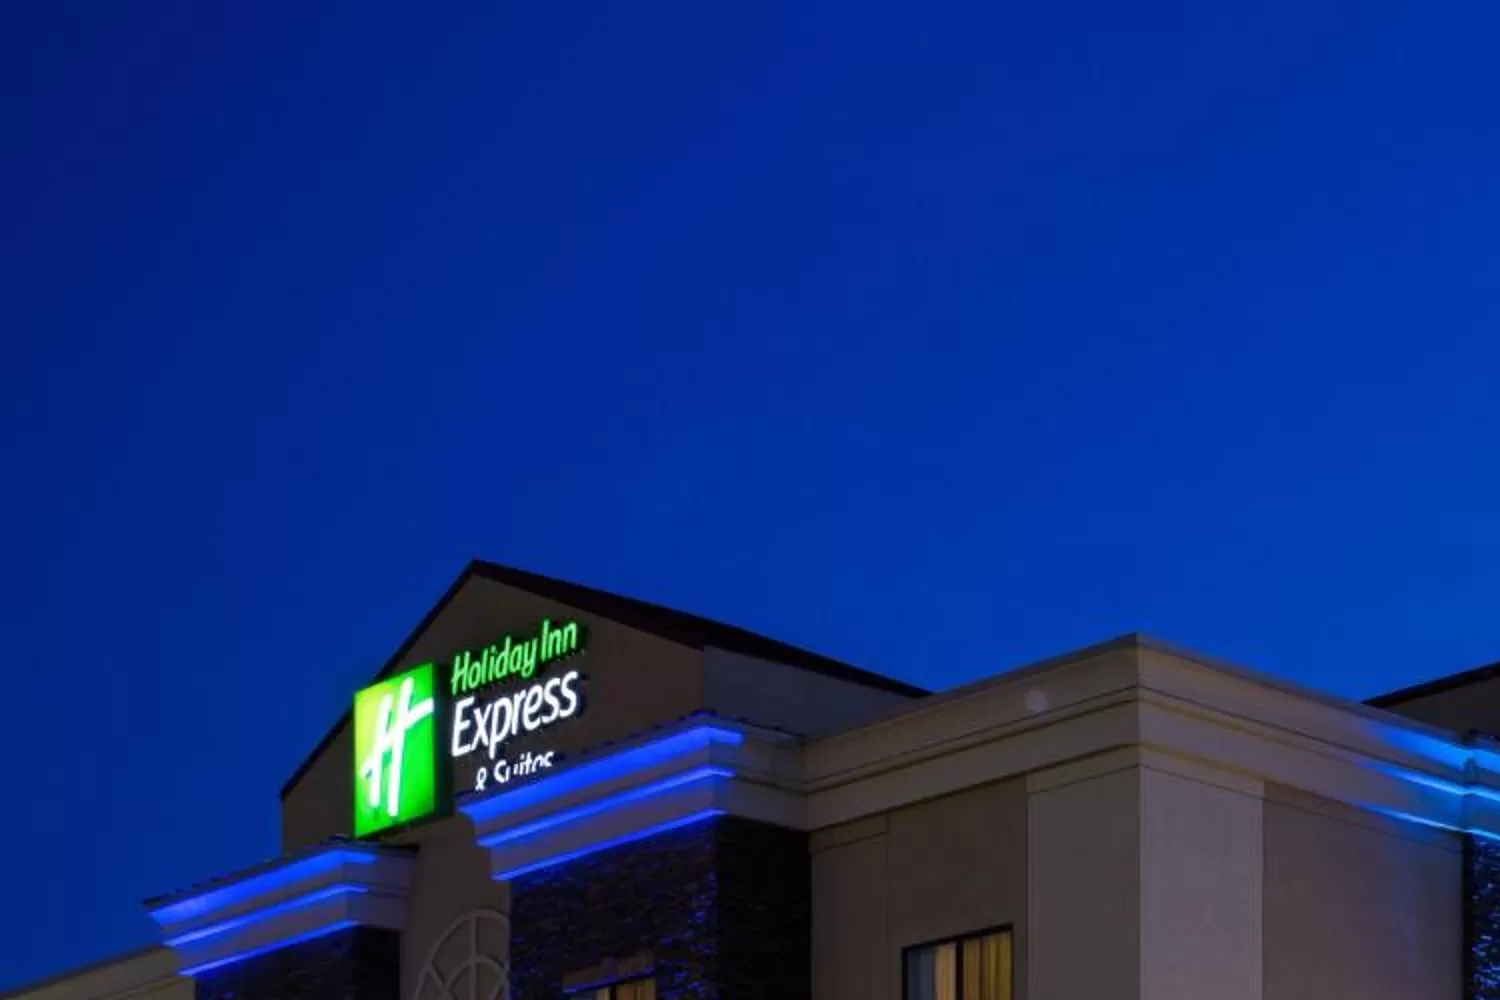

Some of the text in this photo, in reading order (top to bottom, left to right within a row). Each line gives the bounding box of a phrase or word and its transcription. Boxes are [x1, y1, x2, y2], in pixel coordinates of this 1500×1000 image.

[451, 618, 578, 695] Holiday Inn
[451, 670, 578, 760] Express
